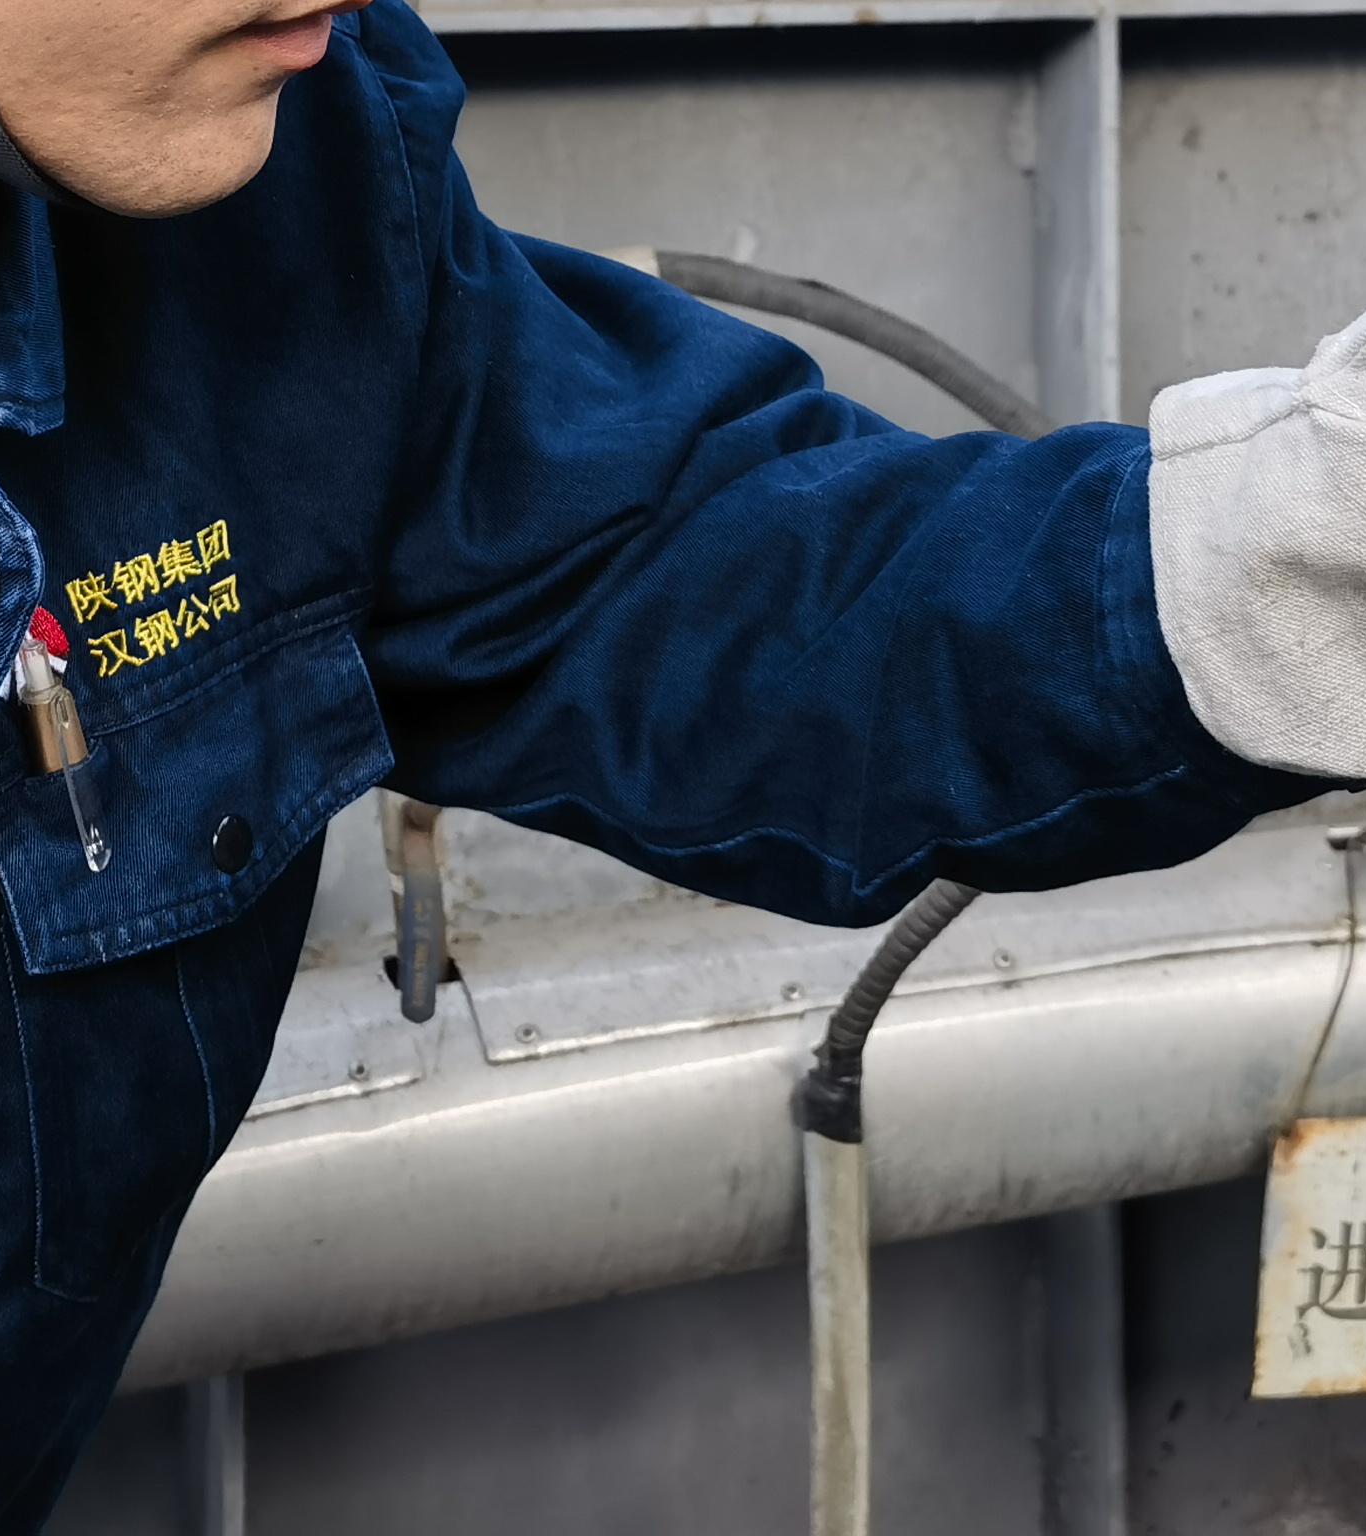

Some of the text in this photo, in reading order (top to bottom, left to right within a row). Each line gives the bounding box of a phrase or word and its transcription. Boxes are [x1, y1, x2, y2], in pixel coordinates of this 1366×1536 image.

[65, 519, 231, 623] 陕钢集团
[88, 574, 241, 677] 汉钢公司
